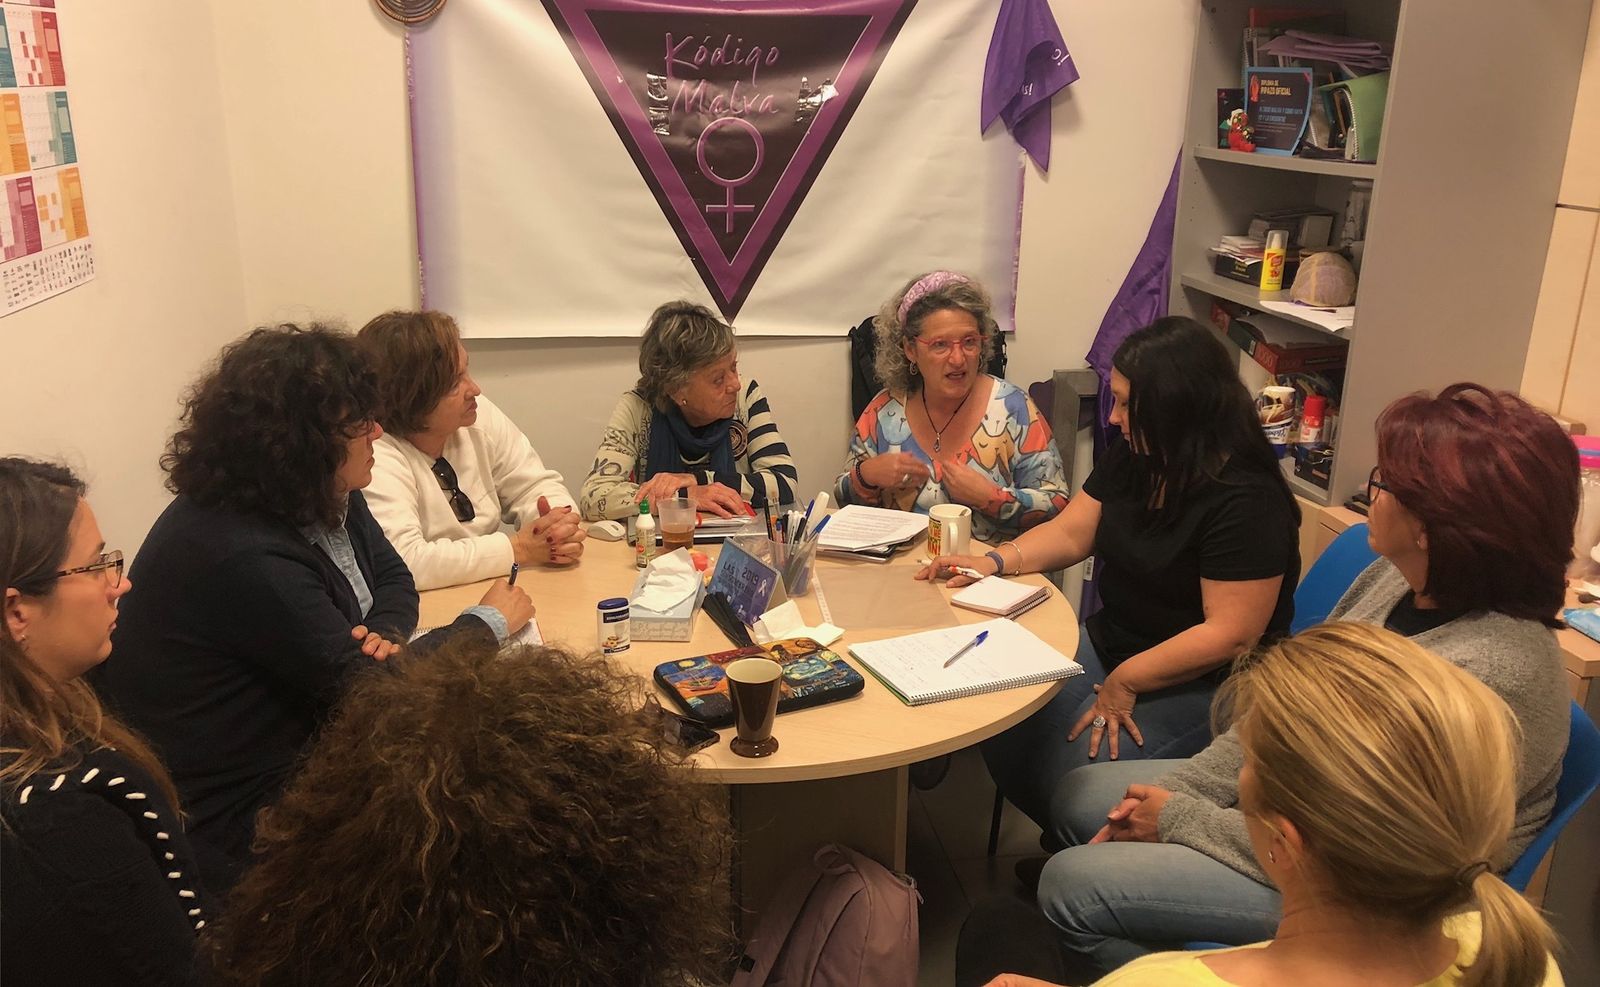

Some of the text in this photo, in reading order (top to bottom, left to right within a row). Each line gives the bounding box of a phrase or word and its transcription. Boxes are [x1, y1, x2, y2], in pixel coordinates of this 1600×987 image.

[664, 32, 780, 87] Kódigo
[671, 78, 780, 117] Malva
[742, 567, 760, 584] 2019
